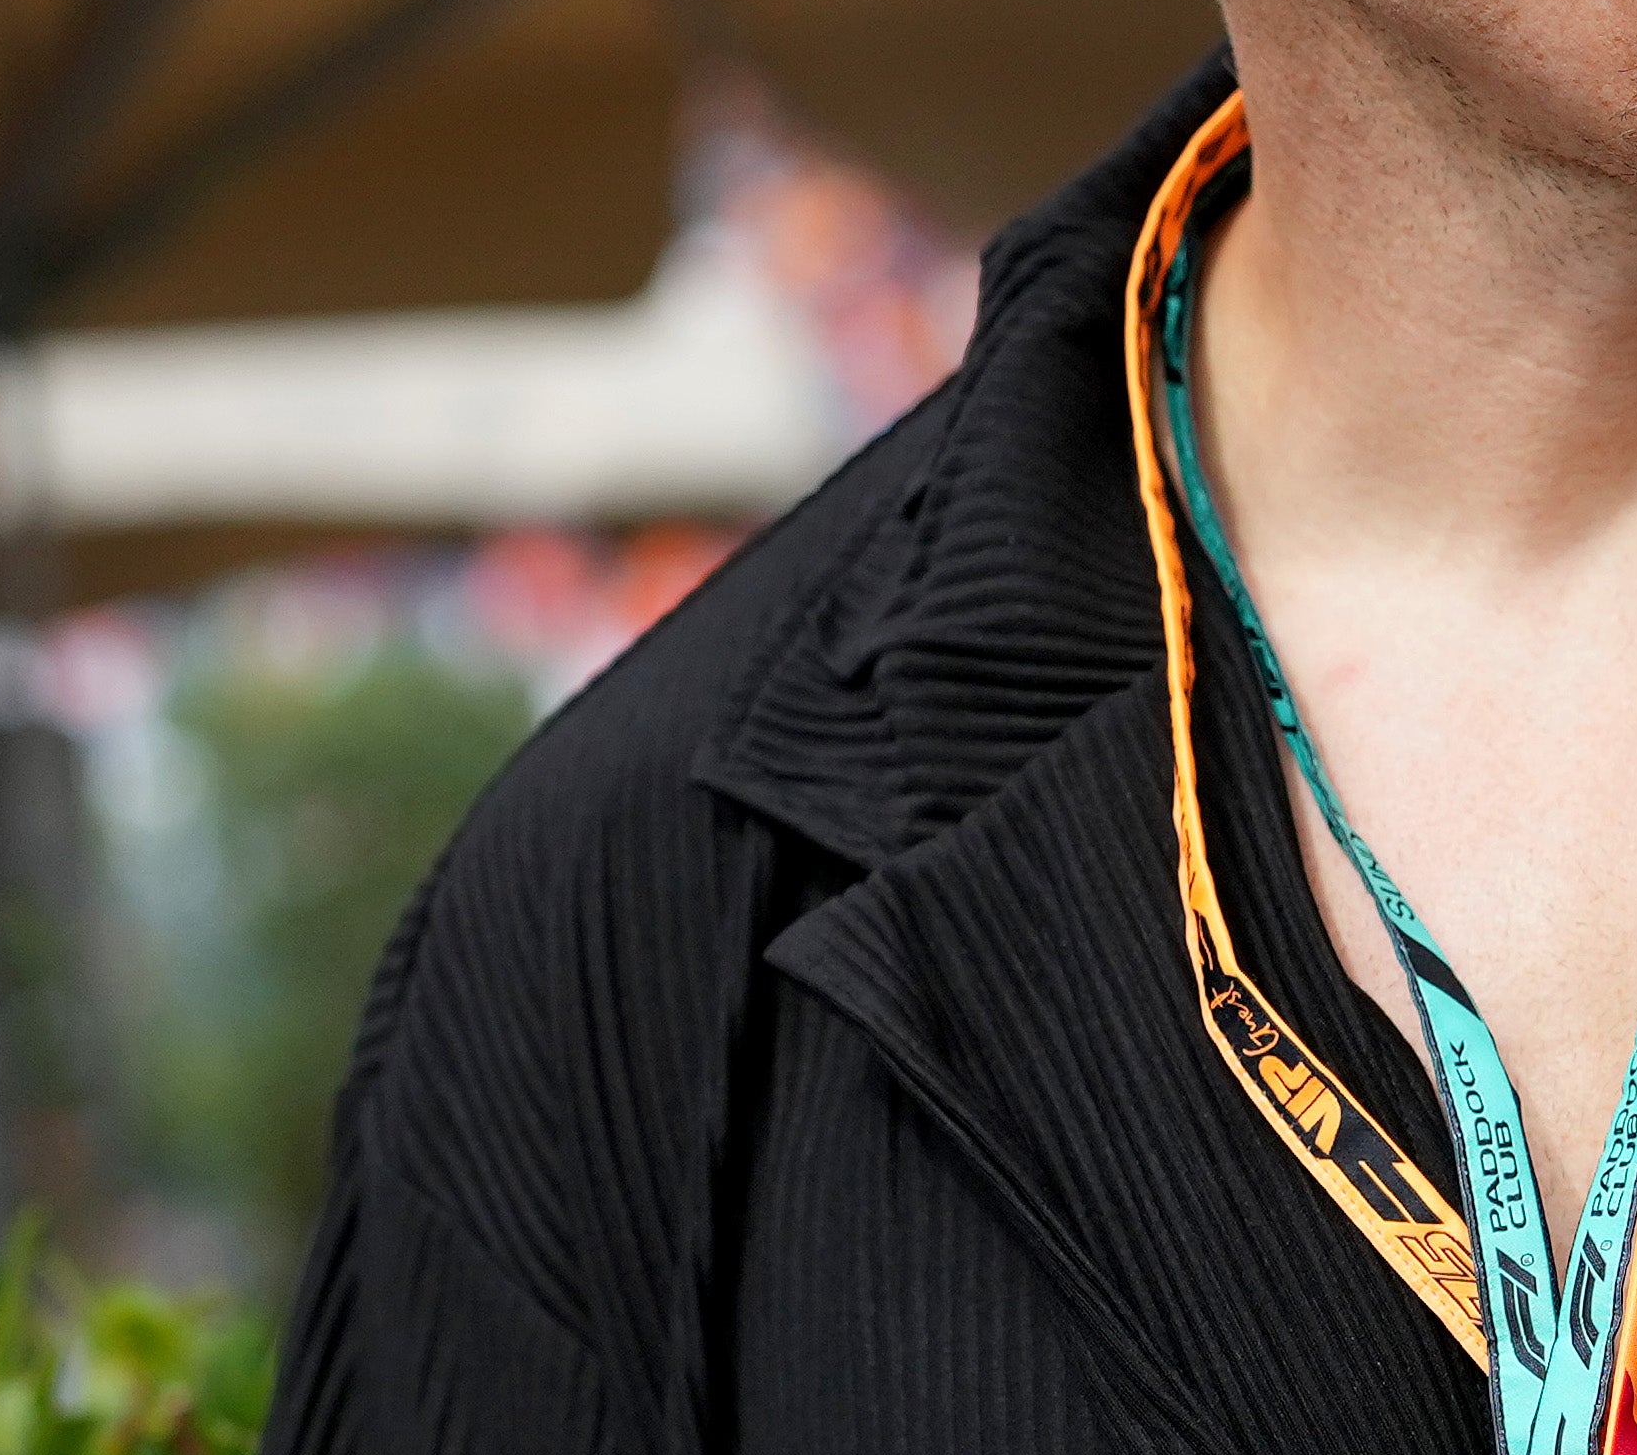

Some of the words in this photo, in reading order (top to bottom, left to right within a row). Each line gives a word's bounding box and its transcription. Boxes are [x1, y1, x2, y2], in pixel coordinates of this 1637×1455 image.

[1210, 980, 1280, 1057] Guest
[1258, 1054, 1343, 1156] VIP
[1449, 1039, 1509, 1233] PADDOCK
[1494, 1119, 1528, 1230] CLUB
[1495, 1246, 1547, 1382] F1
[1568, 1229, 1607, 1371] F1
